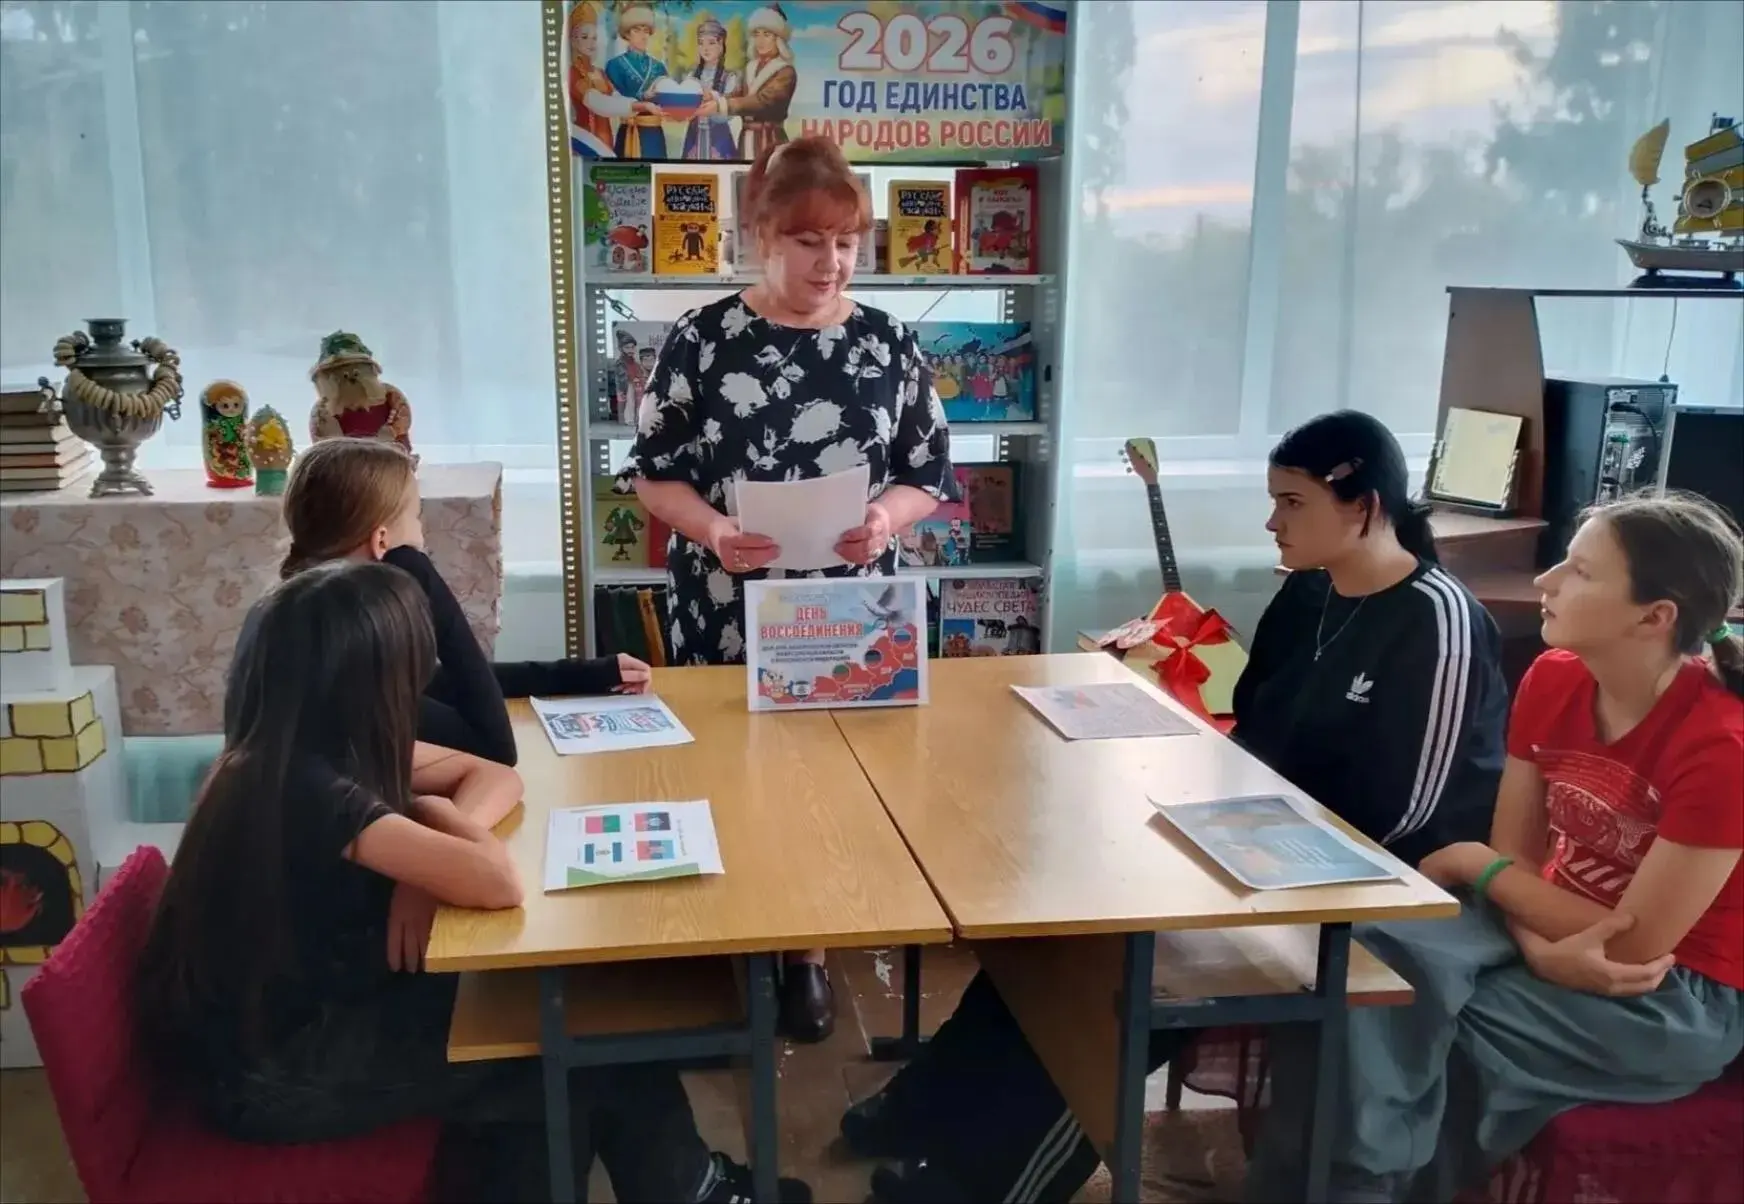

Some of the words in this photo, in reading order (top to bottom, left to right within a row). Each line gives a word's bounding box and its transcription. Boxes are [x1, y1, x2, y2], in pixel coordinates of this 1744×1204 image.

[837, 11, 1016, 75] 2026
[823, 80, 877, 113] ГОД
[886, 82, 1027, 113] ЕДИНСТВА
[801, 118, 931, 151] НАРОДОВ
[940, 120, 1052, 148] РОССИИ
[796, 606, 828, 622] ДЕНЬ
[947, 601, 989, 614] ЧУДЕС
[993, 601, 1036, 613] СВЕТА
[761, 623, 863, 640] ВОССОЕДИНЕНИЯ
